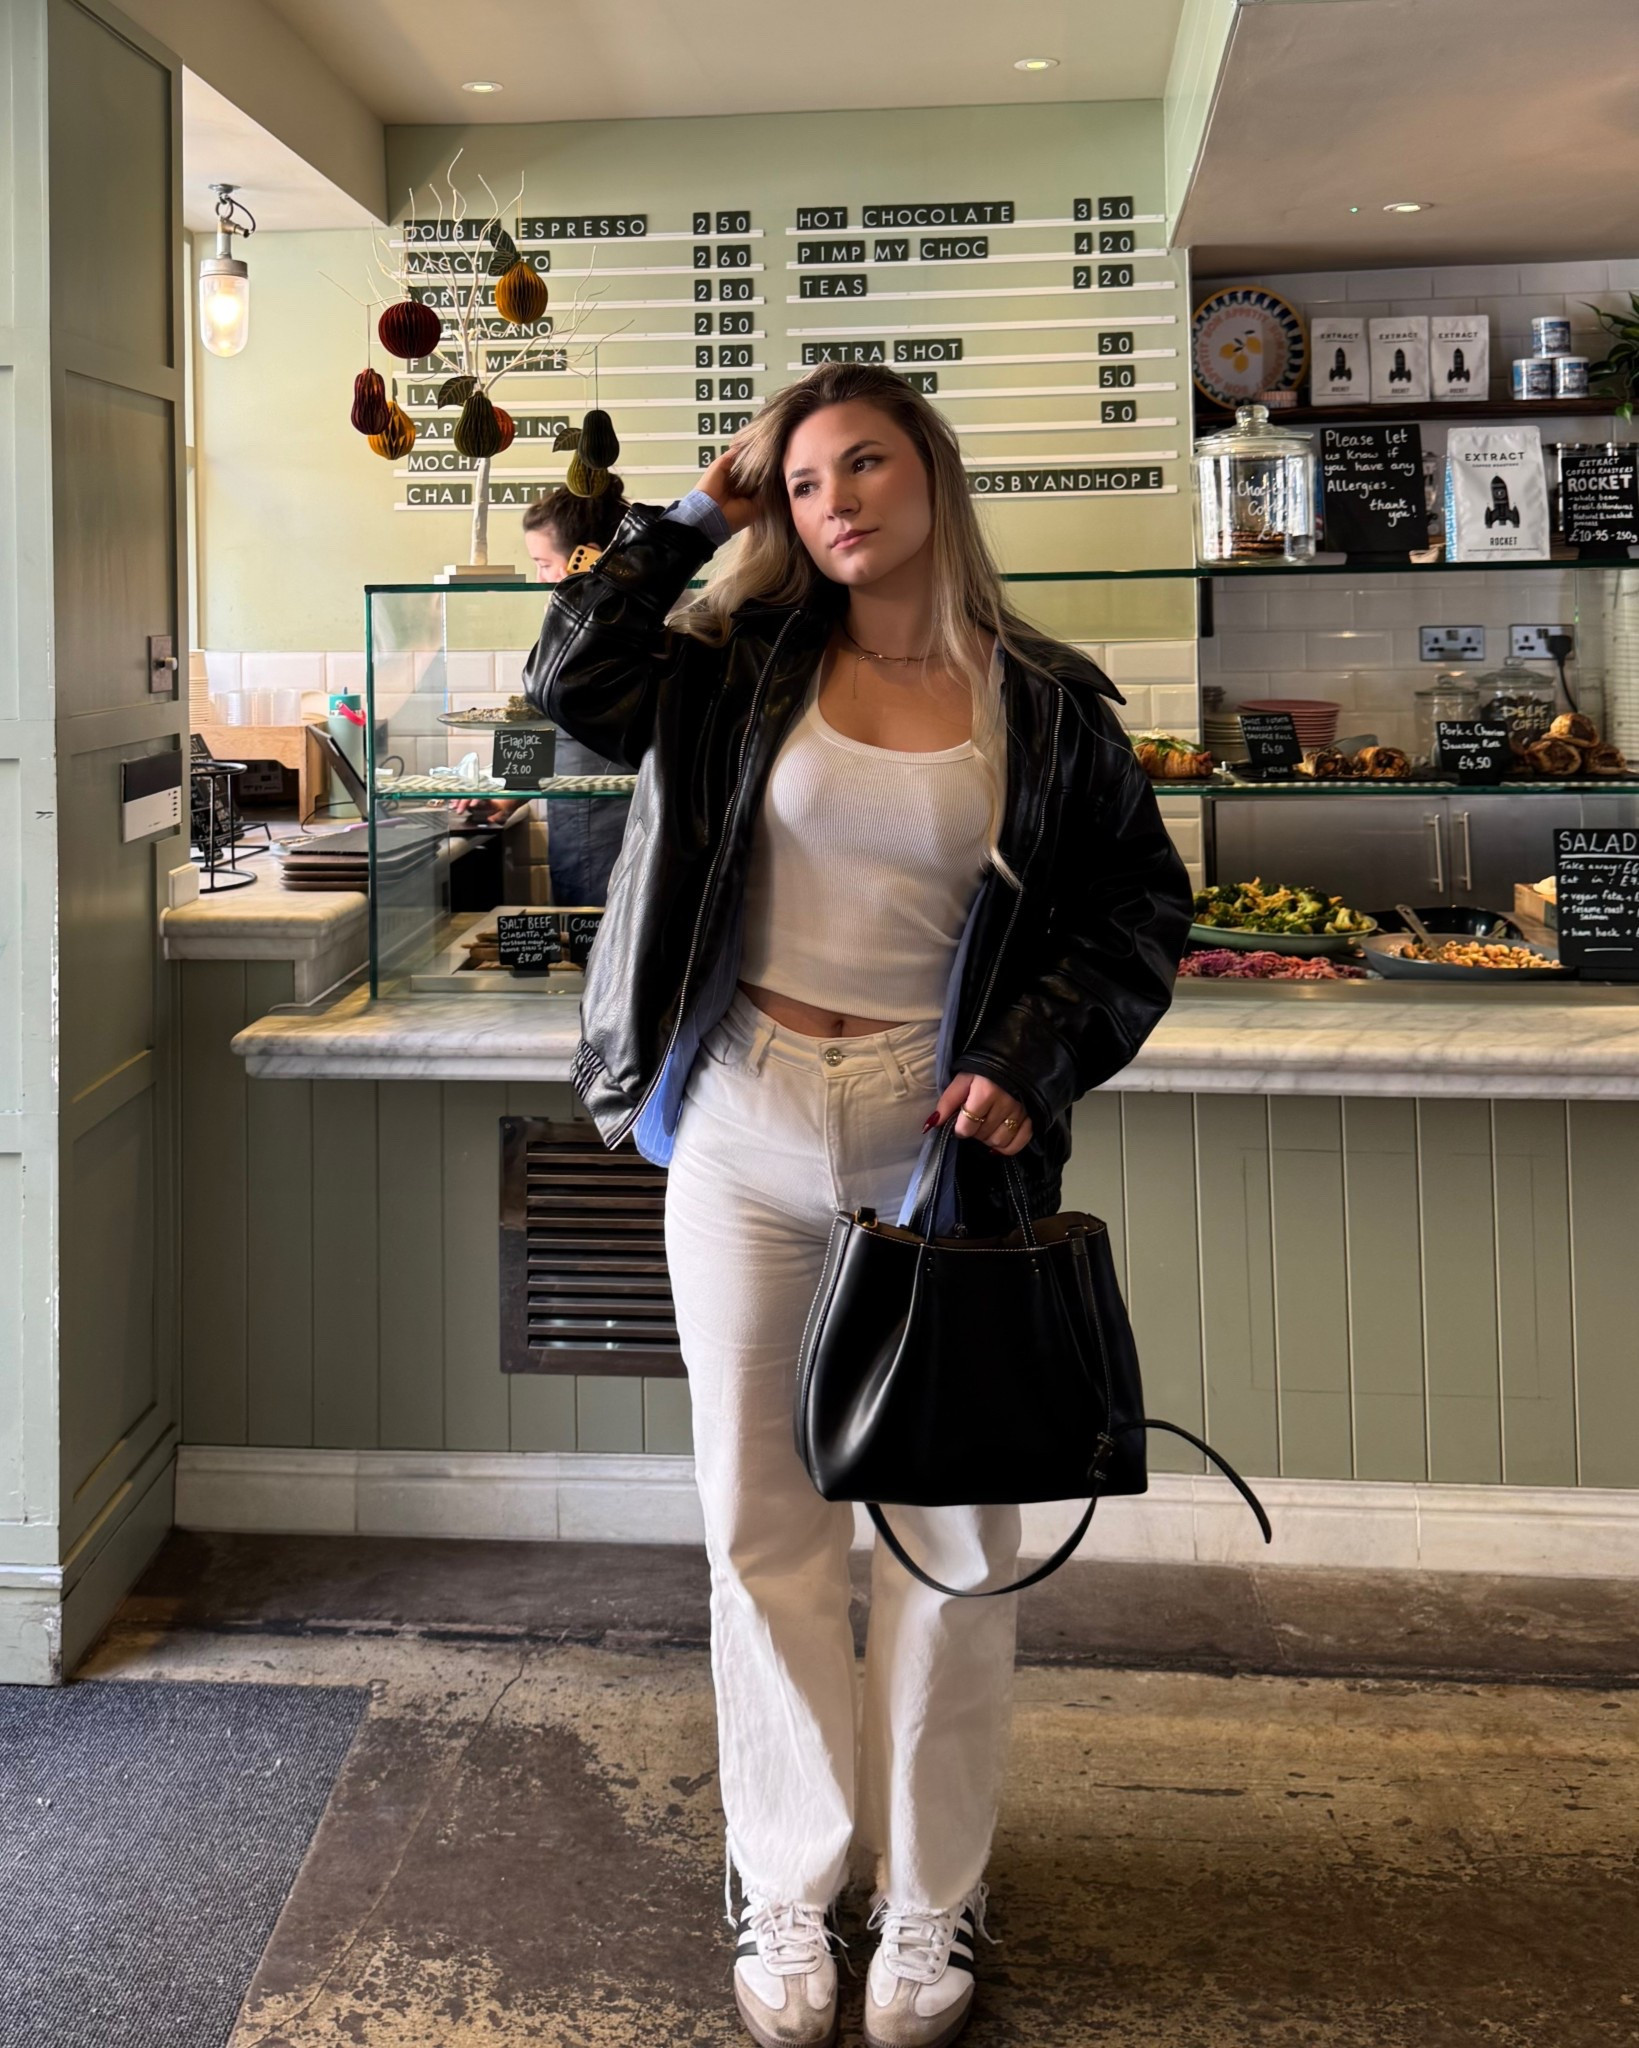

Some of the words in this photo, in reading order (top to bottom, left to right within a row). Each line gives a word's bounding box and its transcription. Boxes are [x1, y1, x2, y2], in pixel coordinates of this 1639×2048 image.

[800, 211, 844, 227] HOT
[864, 206, 1010, 227] CHOCOLATE
[407, 224, 490, 240] DOUBL
[520, 220, 645, 238] ESPRESSO
[802, 246, 861, 262] PIMP
[875, 244, 905, 260] MY
[922, 241, 986, 258] CHOC
[407, 256, 549, 272] MACCHTO
[803, 279, 864, 296] TEAS
[422, 290, 496, 307] ORTAD
[1379, 332, 1419, 340] EXTRACT
[805, 346, 882, 363] EXTRA
[897, 343, 959, 360] SHOT
[1102, 338, 1130, 352] 50
[486, 354, 562, 370] WHITE
[1103, 371, 1132, 385] 50
[1105, 407, 1132, 420] 50
[1325, 430, 1374, 447] Please
[1385, 428, 1408, 444] let
[1325, 453, 1340, 461] us
[1387, 447, 1399, 458] if
[1465, 451, 1525, 461] EXTRACT
[1579, 457, 1620, 467] EXTRACT
[1324, 464, 1347, 476] you
[1355, 462, 1384, 471] have
[1390, 463, 1415, 477] any
[1566, 468, 1596, 477] COFFEE
[1598, 466, 1634, 475] ROASTERS
[966, 471, 1160, 491] OSBYANDHOPE
[1568, 474, 1633, 492] ROCKET
[408, 487, 467, 504] CHAI
[489, 487, 561, 503] LATT
[1369, 499, 1408, 511] thank
[1490, 537, 1518, 546] ROCKET
[1440, 723, 1464, 736] Pork
[500, 732, 542, 750] Flapjack
[501, 762, 532, 776] £3.00
[1458, 755, 1492, 770] £4.50
[1559, 831, 1637, 853] SALAD
[1559, 860, 1585, 871] Take
[1560, 874, 1579, 884] Eat
[1570, 892, 1598, 905] vegan
[499, 917, 525, 930] SALT
[528, 916, 552, 929] BEEF
[1571, 927, 1591, 937] ham
